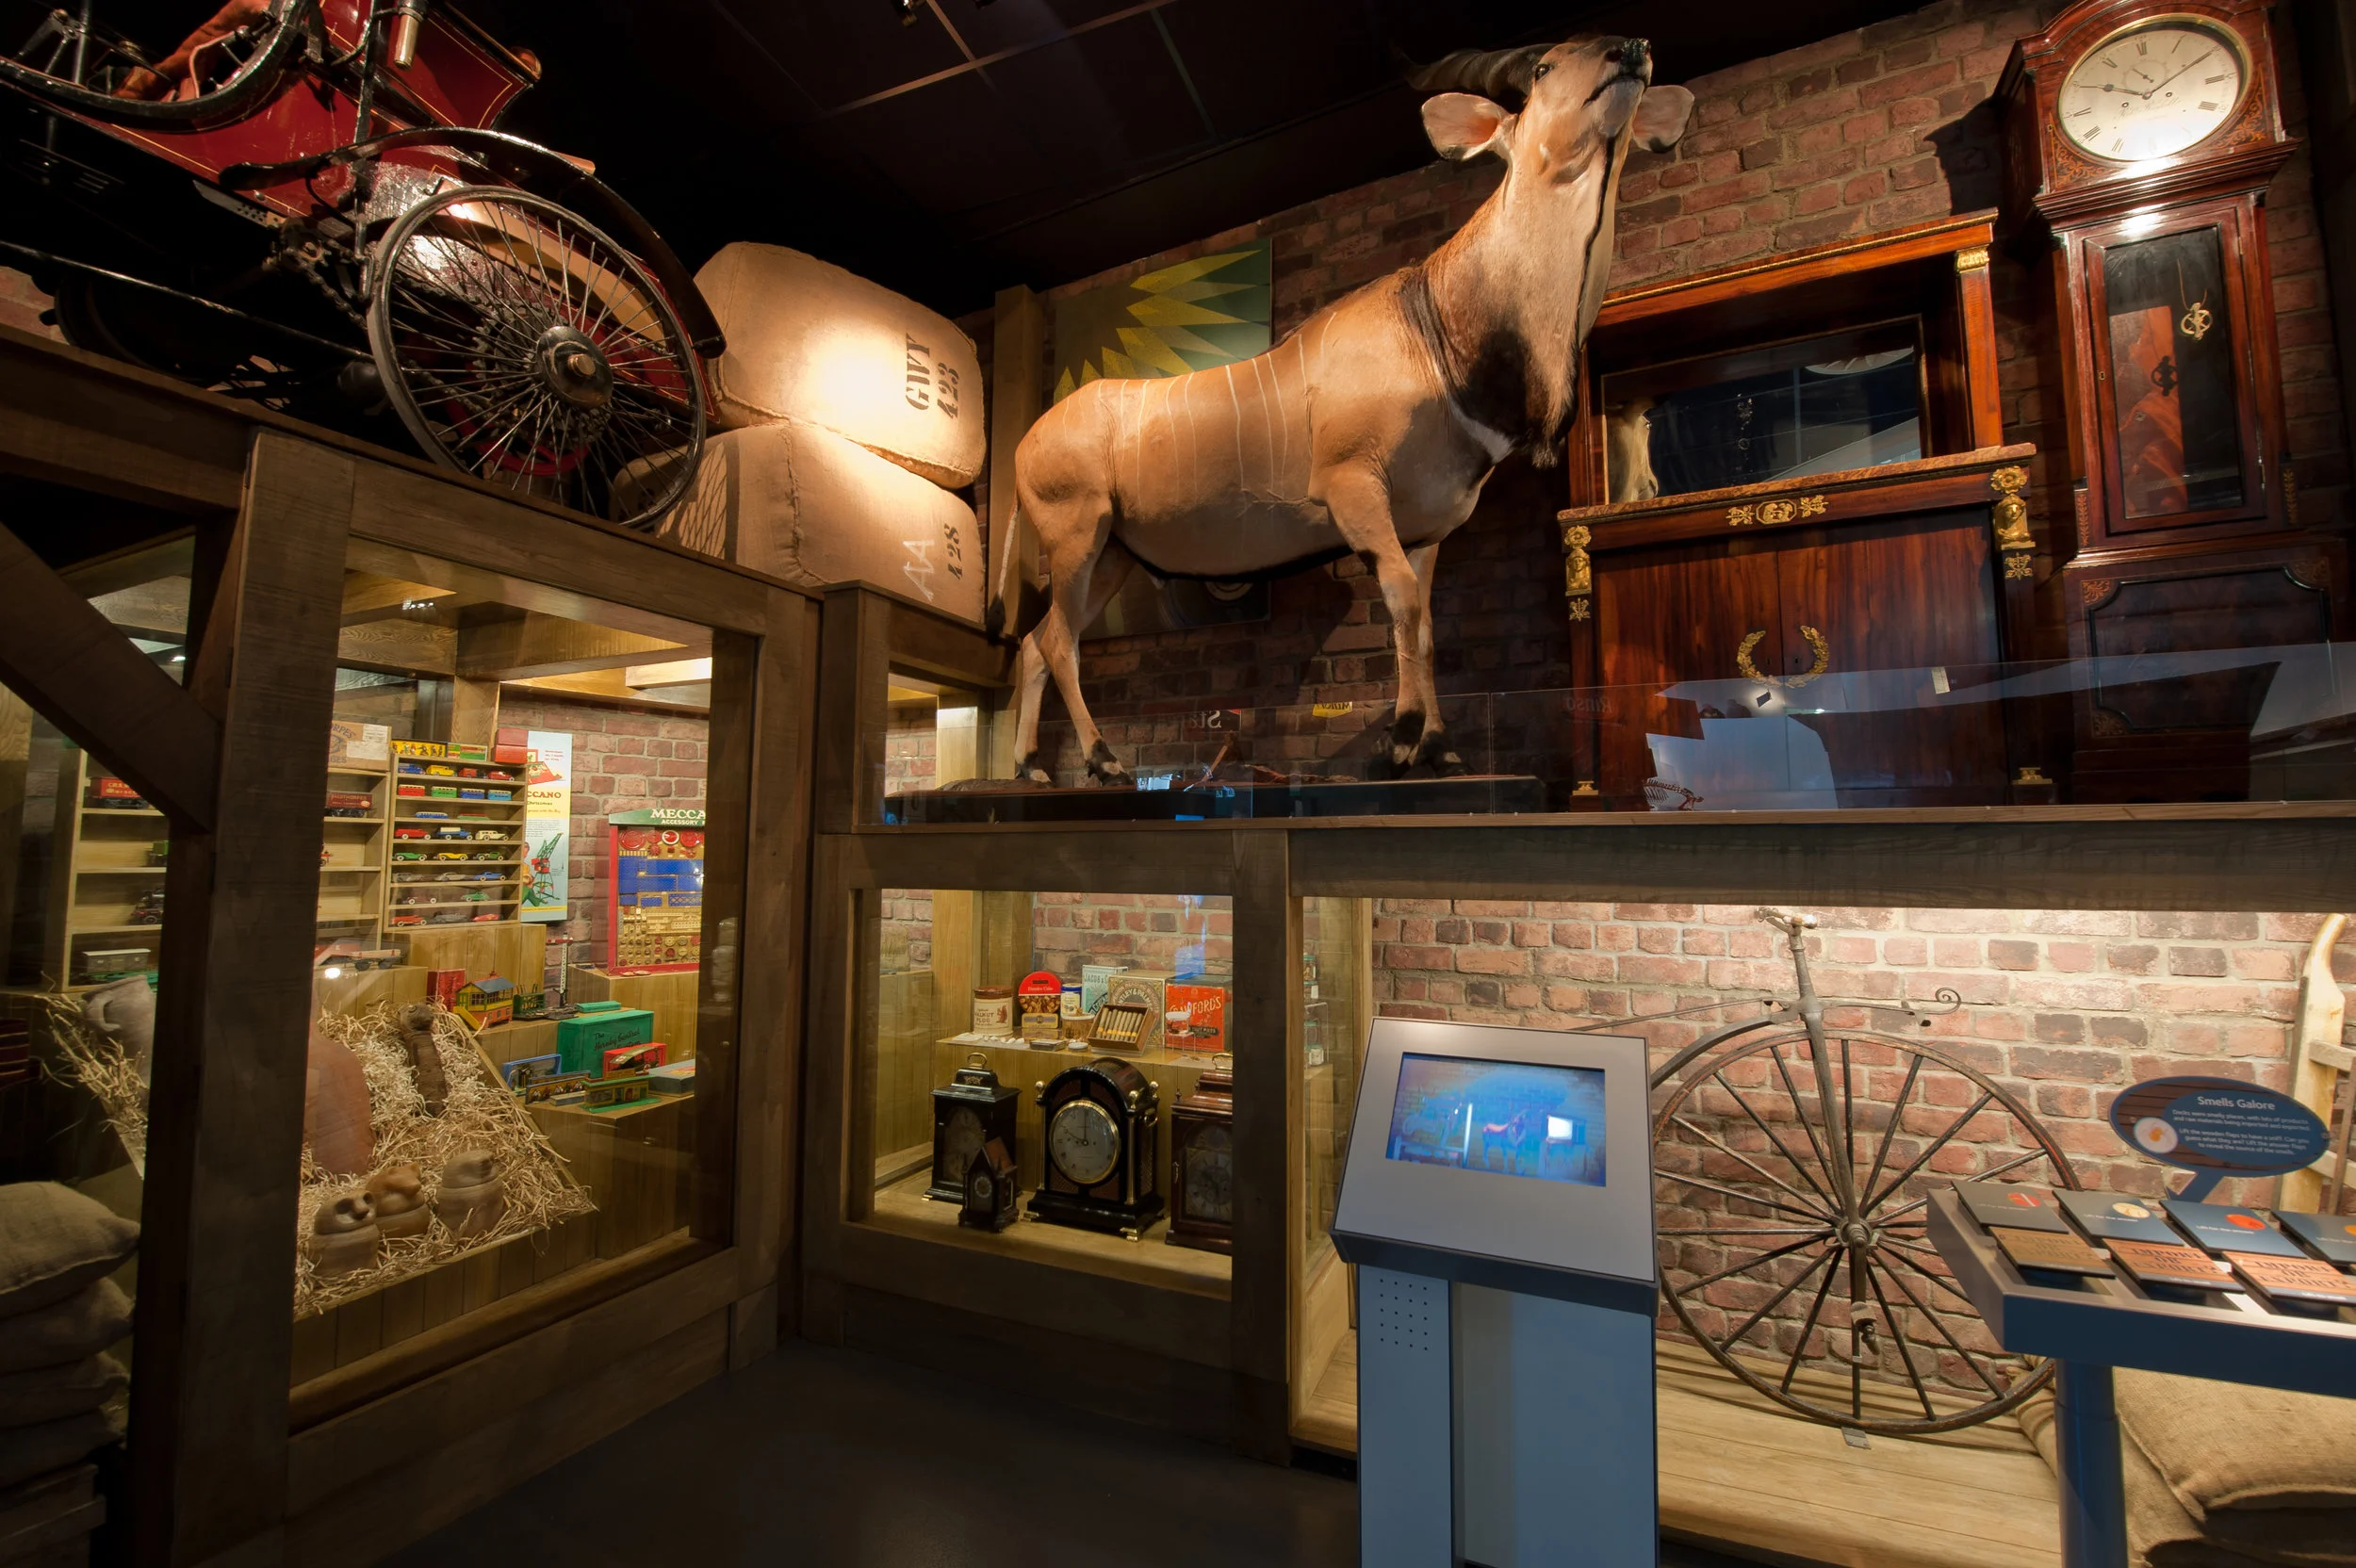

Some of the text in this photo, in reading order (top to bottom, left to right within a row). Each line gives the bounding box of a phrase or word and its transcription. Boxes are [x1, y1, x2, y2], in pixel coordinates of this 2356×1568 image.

[937, 362, 959, 419] 423
[650, 808, 706, 820] MECCA
[2198, 1096, 2276, 1111] Smells Galore
[2132, 1248, 2202, 1259] IMPORT
[2254, 1261, 2331, 1273] IMPORT
